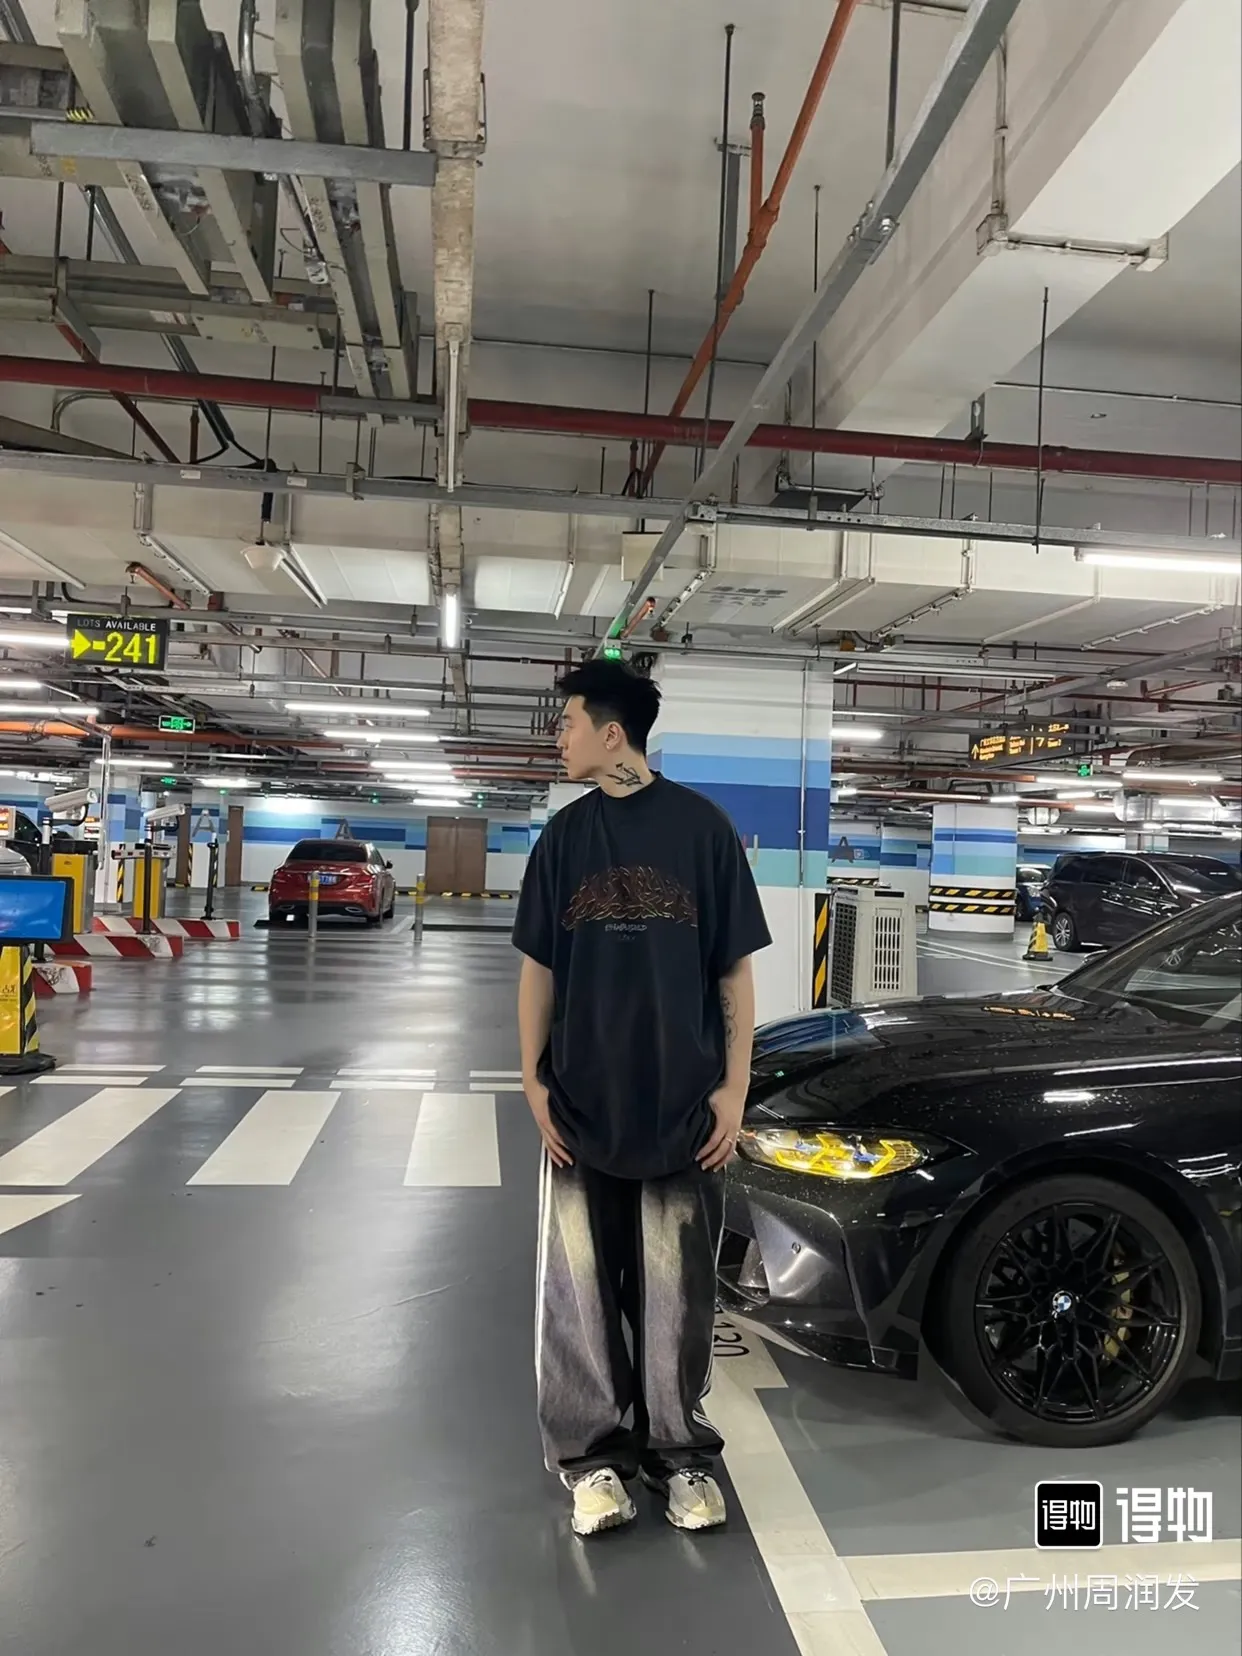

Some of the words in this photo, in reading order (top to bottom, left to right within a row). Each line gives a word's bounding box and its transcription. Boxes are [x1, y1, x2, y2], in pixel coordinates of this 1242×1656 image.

[77, 619, 100, 628] LOTS
[105, 620, 156, 632] AVAILABLE
[714, 1304, 750, 1357] 130
